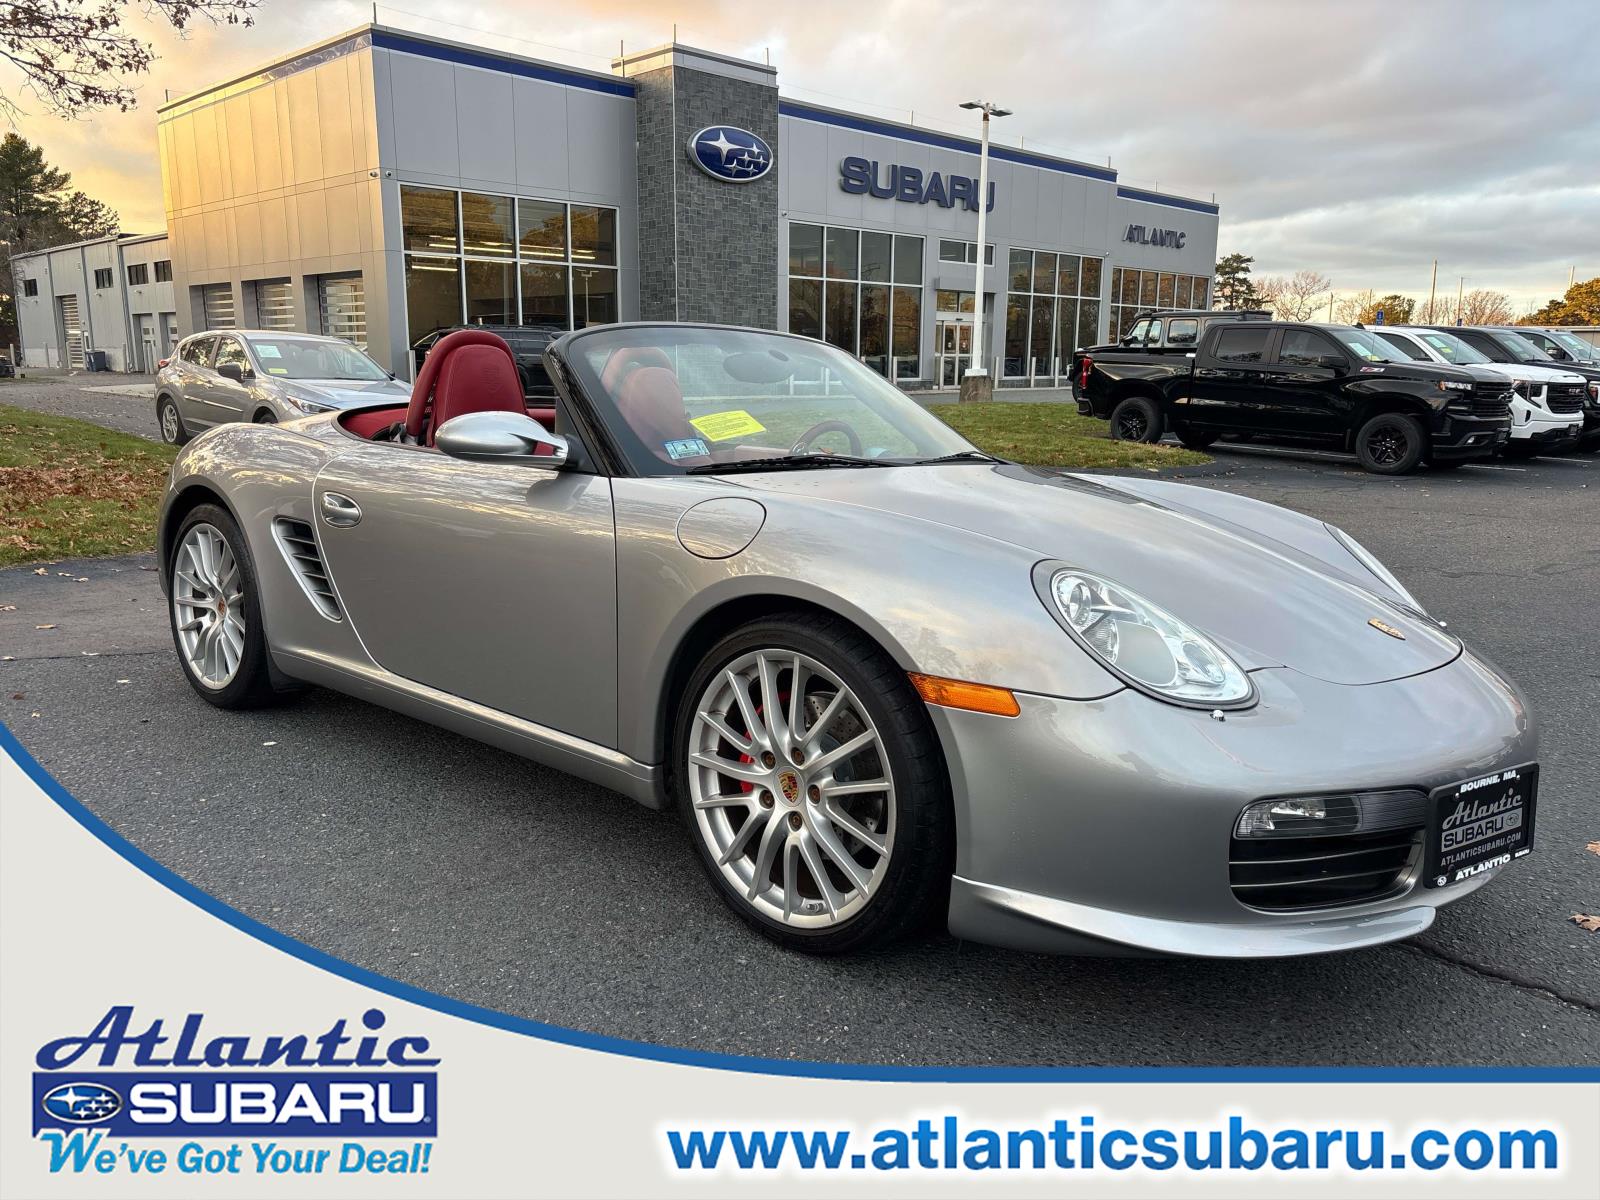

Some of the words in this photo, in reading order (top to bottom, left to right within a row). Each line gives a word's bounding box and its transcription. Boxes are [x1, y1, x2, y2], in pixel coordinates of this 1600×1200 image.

[841, 156, 995, 214] SUBARU
[1122, 223, 1187, 249] ATLANTIC
[1460, 774, 1501, 793] BOURNE,
[1442, 787, 1523, 830] Atlantic
[1440, 831, 1522, 867] ATLANTICSUBARU.COM
[1443, 816, 1504, 849] SUBARU
[1455, 853, 1511, 880] ATLANTIC
